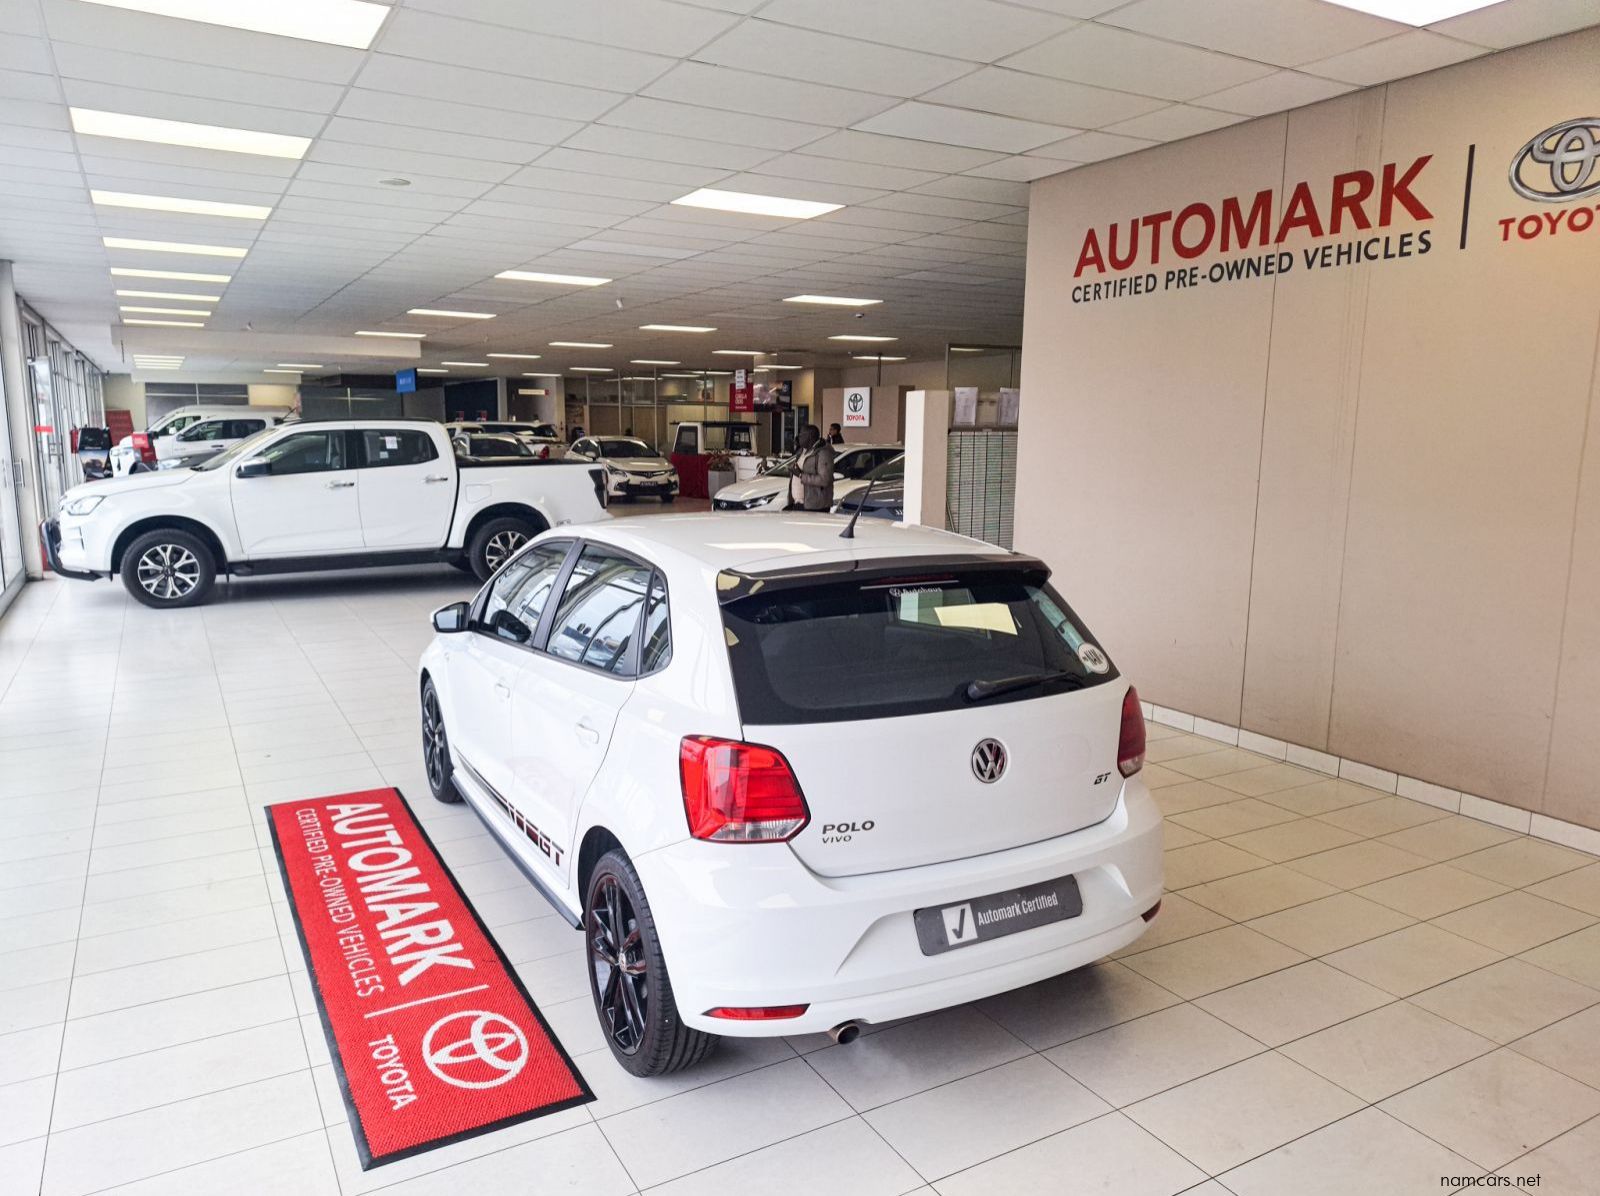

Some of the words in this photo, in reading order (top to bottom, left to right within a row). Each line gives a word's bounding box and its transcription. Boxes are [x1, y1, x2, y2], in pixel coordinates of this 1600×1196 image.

[1074, 154, 1434, 279] AUTOMARK
[1498, 204, 1600, 242] TOYO
[1071, 275, 1158, 304] CERTIFIED
[1164, 251, 1294, 291] PRE-OWNED
[1303, 229, 1432, 270] VEHICLES
[846, 414, 866, 422] TOYOTA
[1093, 771, 1112, 786] GT
[295, 807, 329, 854] CERTIFIED
[822, 819, 875, 835] POLO
[822, 834, 852, 844] VIVO
[539, 830, 565, 868] GT
[311, 854, 356, 924] PRE-OWNED
[326, 802, 475, 987] AUTOMARK
[977, 902, 1022, 927] Automark
[1021, 891, 1059, 915] Certified
[336, 923, 384, 998] VEHICLES
[368, 1033, 420, 1111] TOYOTA
